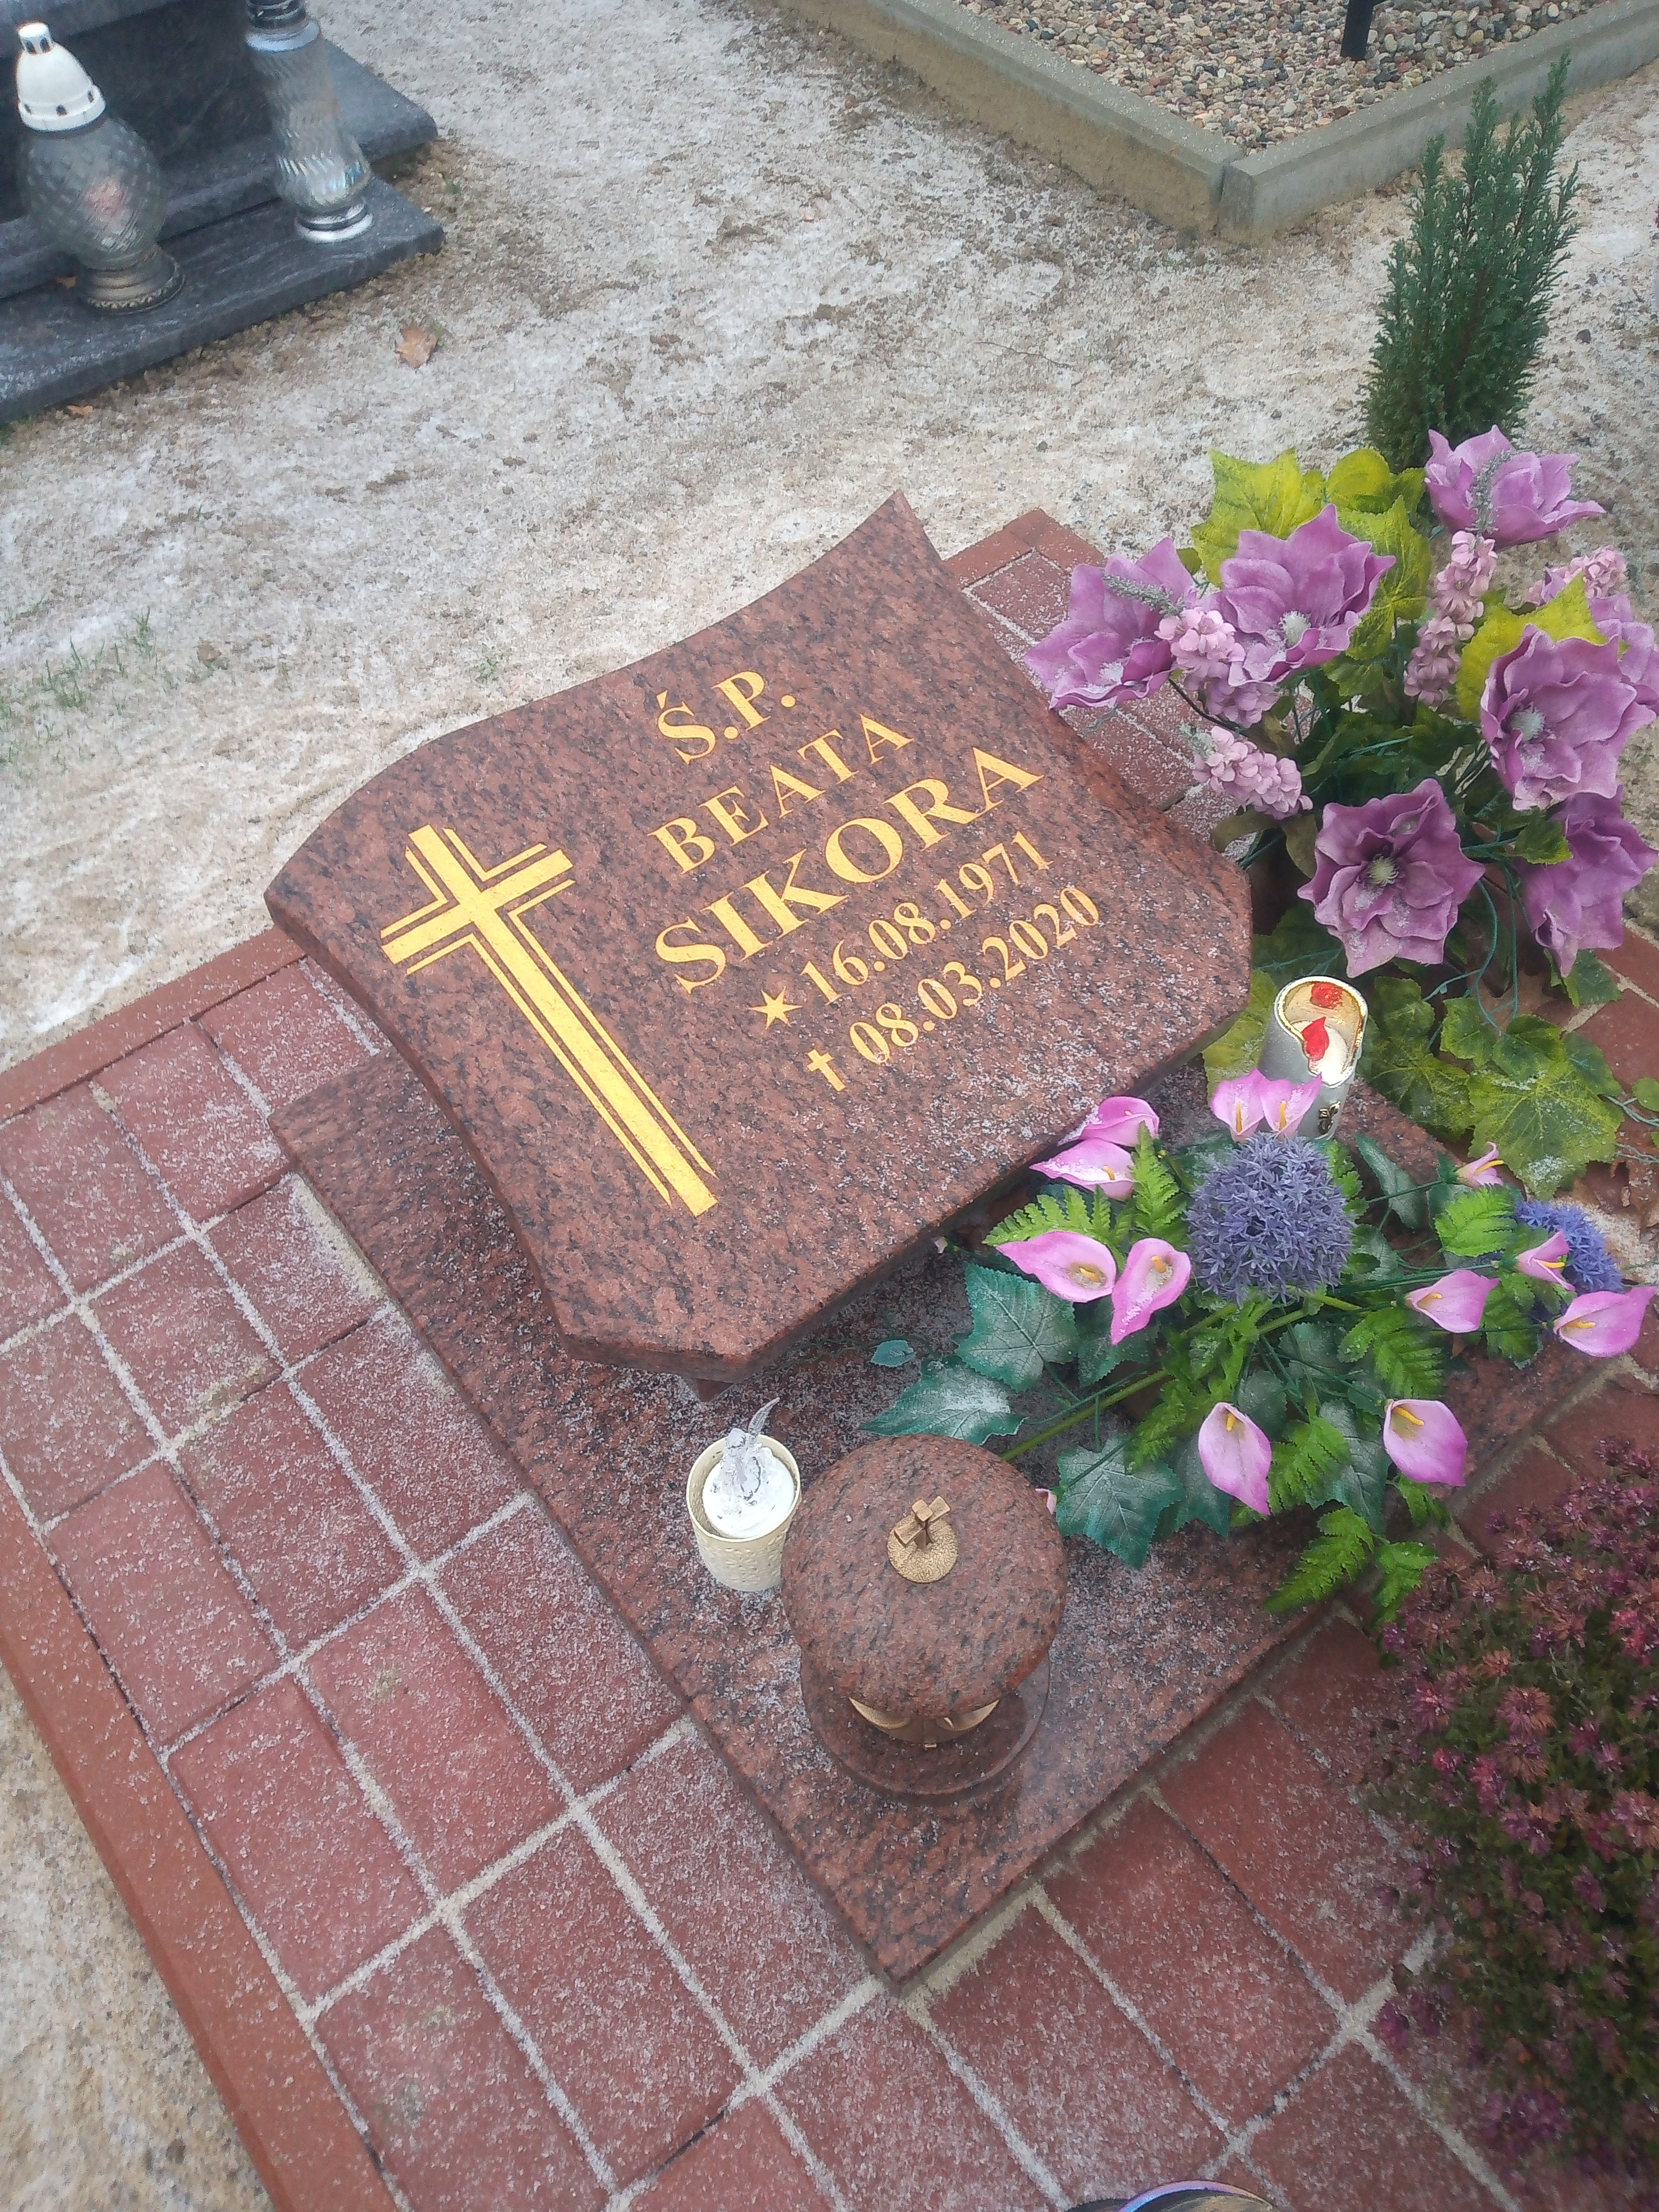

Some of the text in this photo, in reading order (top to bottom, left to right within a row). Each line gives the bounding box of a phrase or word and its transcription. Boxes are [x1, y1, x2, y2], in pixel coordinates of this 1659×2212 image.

[648, 714, 914, 874] BEATA
[656, 671, 796, 764] Ś.P.
[655, 747, 1044, 994] SIKORA
[801, 832, 1053, 1004] 16.08.1971
[849, 887, 1100, 1064] 08.03.2020
